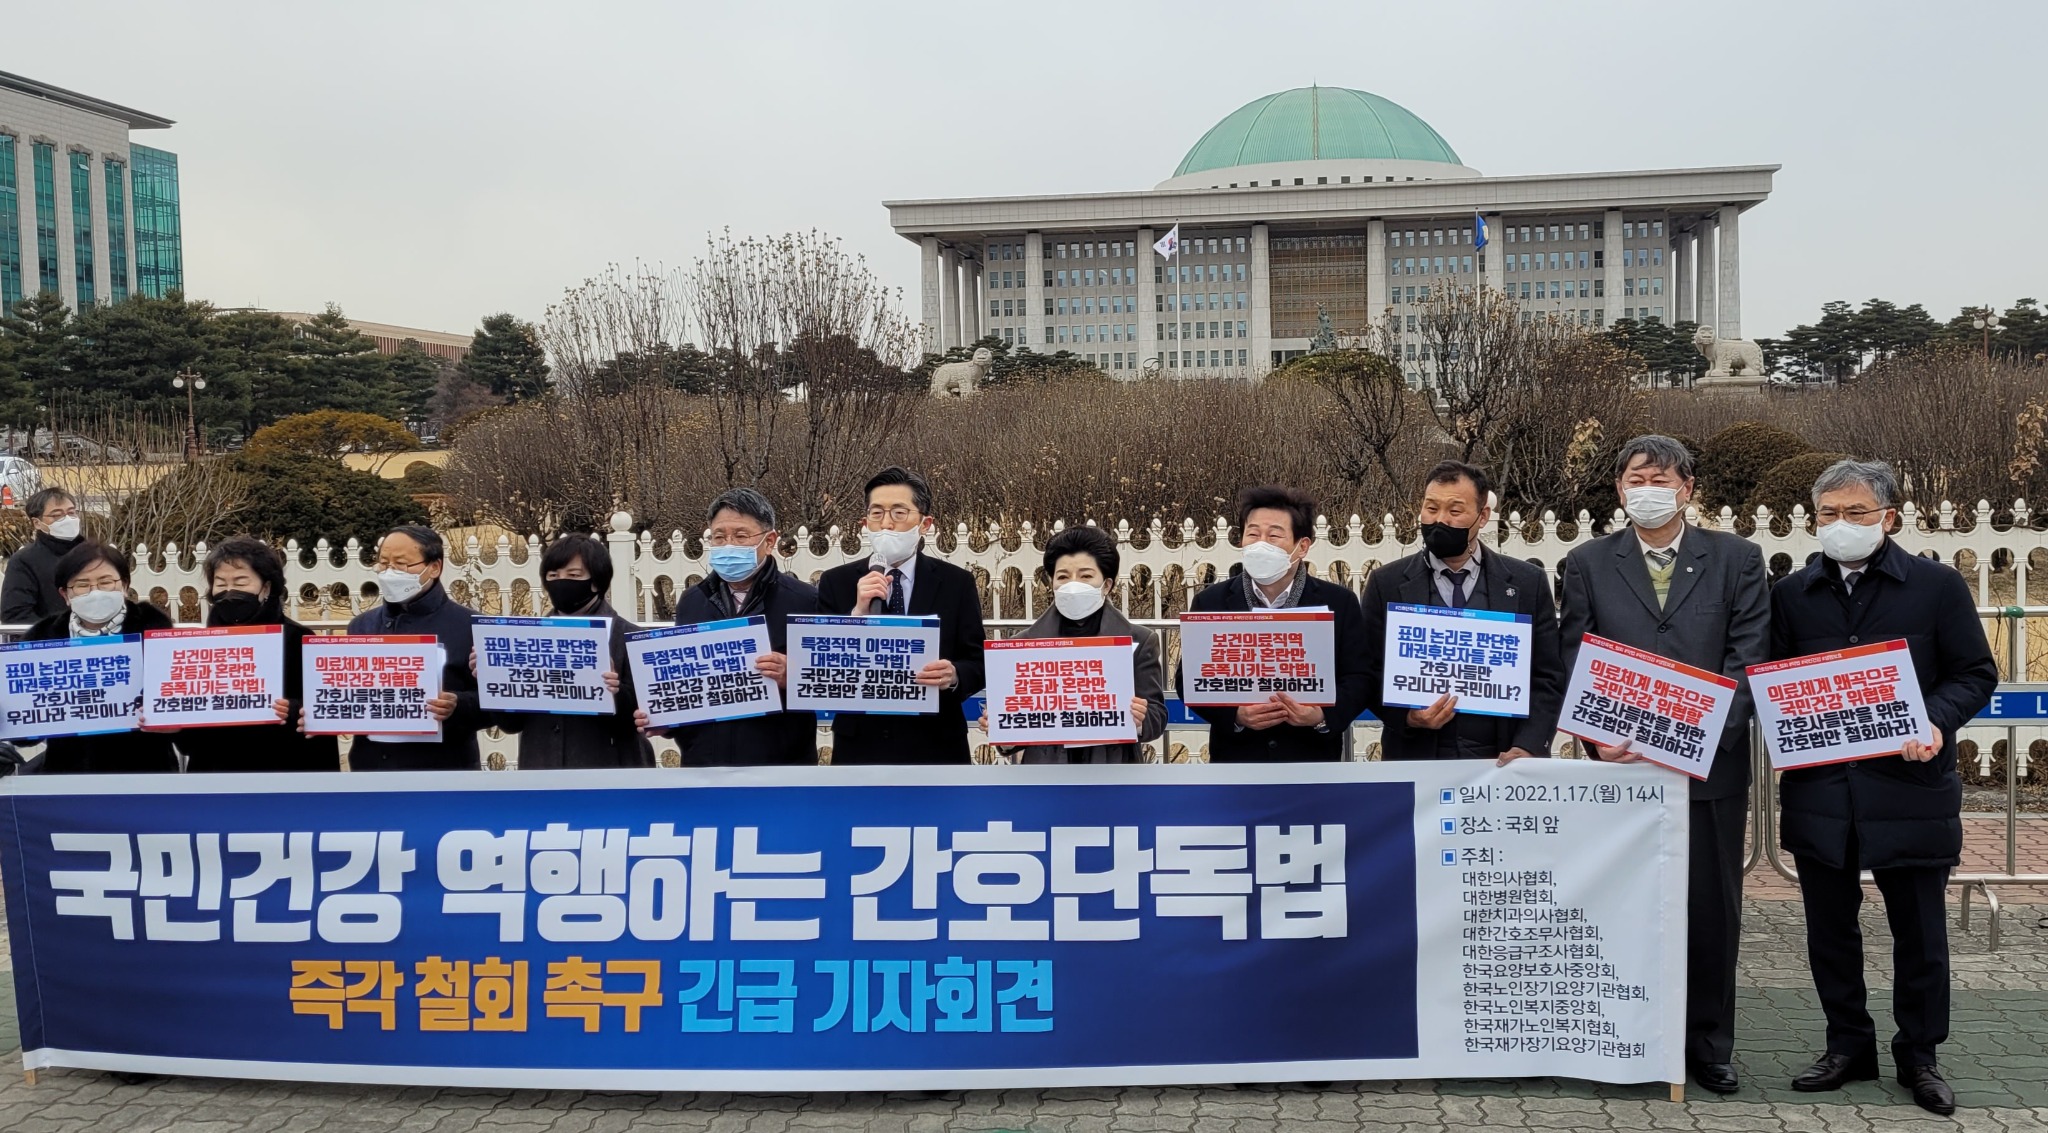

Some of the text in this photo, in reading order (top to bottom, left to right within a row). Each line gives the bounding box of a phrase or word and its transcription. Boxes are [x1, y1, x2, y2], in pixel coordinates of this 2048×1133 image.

[484, 637, 598, 654] 표의 논리로 판단한
[801, 637, 925, 654] 특정직역 이익만을
[1212, 633, 1303, 647] 보건의료직역
[1398, 625, 1520, 651] 표의 논리로 판단한
[172, 647, 254, 665] 보건의료직역
[487, 652, 597, 670] 대권후보자들 공약
[642, 638, 757, 666] 특정직역 이익만을
[811, 652, 911, 669] 대변하는 악법!
[1211, 648, 1306, 662] 갈등과 혼란만
[1399, 642, 1518, 667] 대권후보자들 공약
[5, 655, 131, 679] 표의 논리로 판단한
[170, 663, 256, 680] 갈등과 혼란만
[315, 656, 424, 672] 의료체계 왜곡으로
[653, 656, 747, 682] 대변하는 악법!
[1016, 660, 1103, 678] 보건의료직역
[1201, 663, 1316, 677] 증폭시키는 악법!
[1420, 661, 1492, 681] 간호사들만
[9, 671, 131, 694] 대권후보자들 공약
[322, 672, 375, 688] 국민건강
[508, 668, 575, 684] 간호사들만
[648, 671, 763, 697] 국민건강 외면하는
[801, 668, 861, 683] 국민건강
[1767, 665, 1901, 702] 의료체계 왜곡으로
[161, 678, 265, 697] 증폭시키는 악법!
[486, 683, 604, 701] 우리나라 국민이냐?
[797, 683, 927, 701] 간호법안 철회하라!
[1014, 677, 1107, 695] 갈등과 혼란만
[1194, 678, 1324, 692] 간호법안 철회하라!
[1393, 675, 1521, 701] 우리나라 국민이냐?
[1589, 659, 1716, 713] 의료체계 왜곡으로
[1592, 676, 1654, 710] 국민건강
[32, 689, 106, 708] 간호사들만
[153, 694, 272, 713] 간호법안 철회하라!
[316, 688, 425, 703] 간호사들만을 위한
[647, 685, 769, 714] 간호법안 철회하라!
[1005, 694, 1116, 712] 증폭시키는 악법!
[1779, 693, 1842, 716] 국민건강
[7, 701, 136, 725] 우리나라 국민이냐?
[313, 704, 428, 720] 간호법안 철회하라!
[998, 711, 1125, 729] 간호법안 철회하라!
[1579, 690, 1707, 745] 간호사들만을 위한
[1776, 700, 1909, 736] 간호사들만을 위한
[1572, 705, 1704, 762] 간호법안 철회하라!
[1777, 717, 1918, 754] 간호법안 철회하라!
[1459, 785, 1492, 803] 일시
[1504, 784, 1621, 804] 2022.1.17.(월)
[1627, 785, 1664, 804] 14시
[1460, 816, 1493, 834] 장소
[1505, 816, 1539, 834] 국회
[1543, 816, 1560, 834] 앞
[1461, 848, 1494, 866] 주최
[49, 820, 1348, 943] 국민건강 역행하는 간호단독법
[1462, 871, 1557, 887] 대한의사협회,
[1463, 889, 1557, 906] 대한병원협회,
[1464, 908, 1588, 924] 대한치과의사협회,
[1463, 926, 1603, 942] 대한간호조무사협회,
[1462, 944, 1604, 961] 대한응급구조사협회,
[1462, 962, 1619, 981] 한국요양보호사중앙회,
[289, 956, 1054, 1033] 즉각 철회 촉구 긴급 기자회견
[1463, 981, 1649, 1002] 한국노인장기요양기관협회,
[1463, 1000, 1605, 1018] 한국노인복지중앙회,
[1464, 1018, 1620, 1039] 한국재가노인복지협회,
[1464, 1037, 1645, 1059] 한국재가장기요양기관협회
